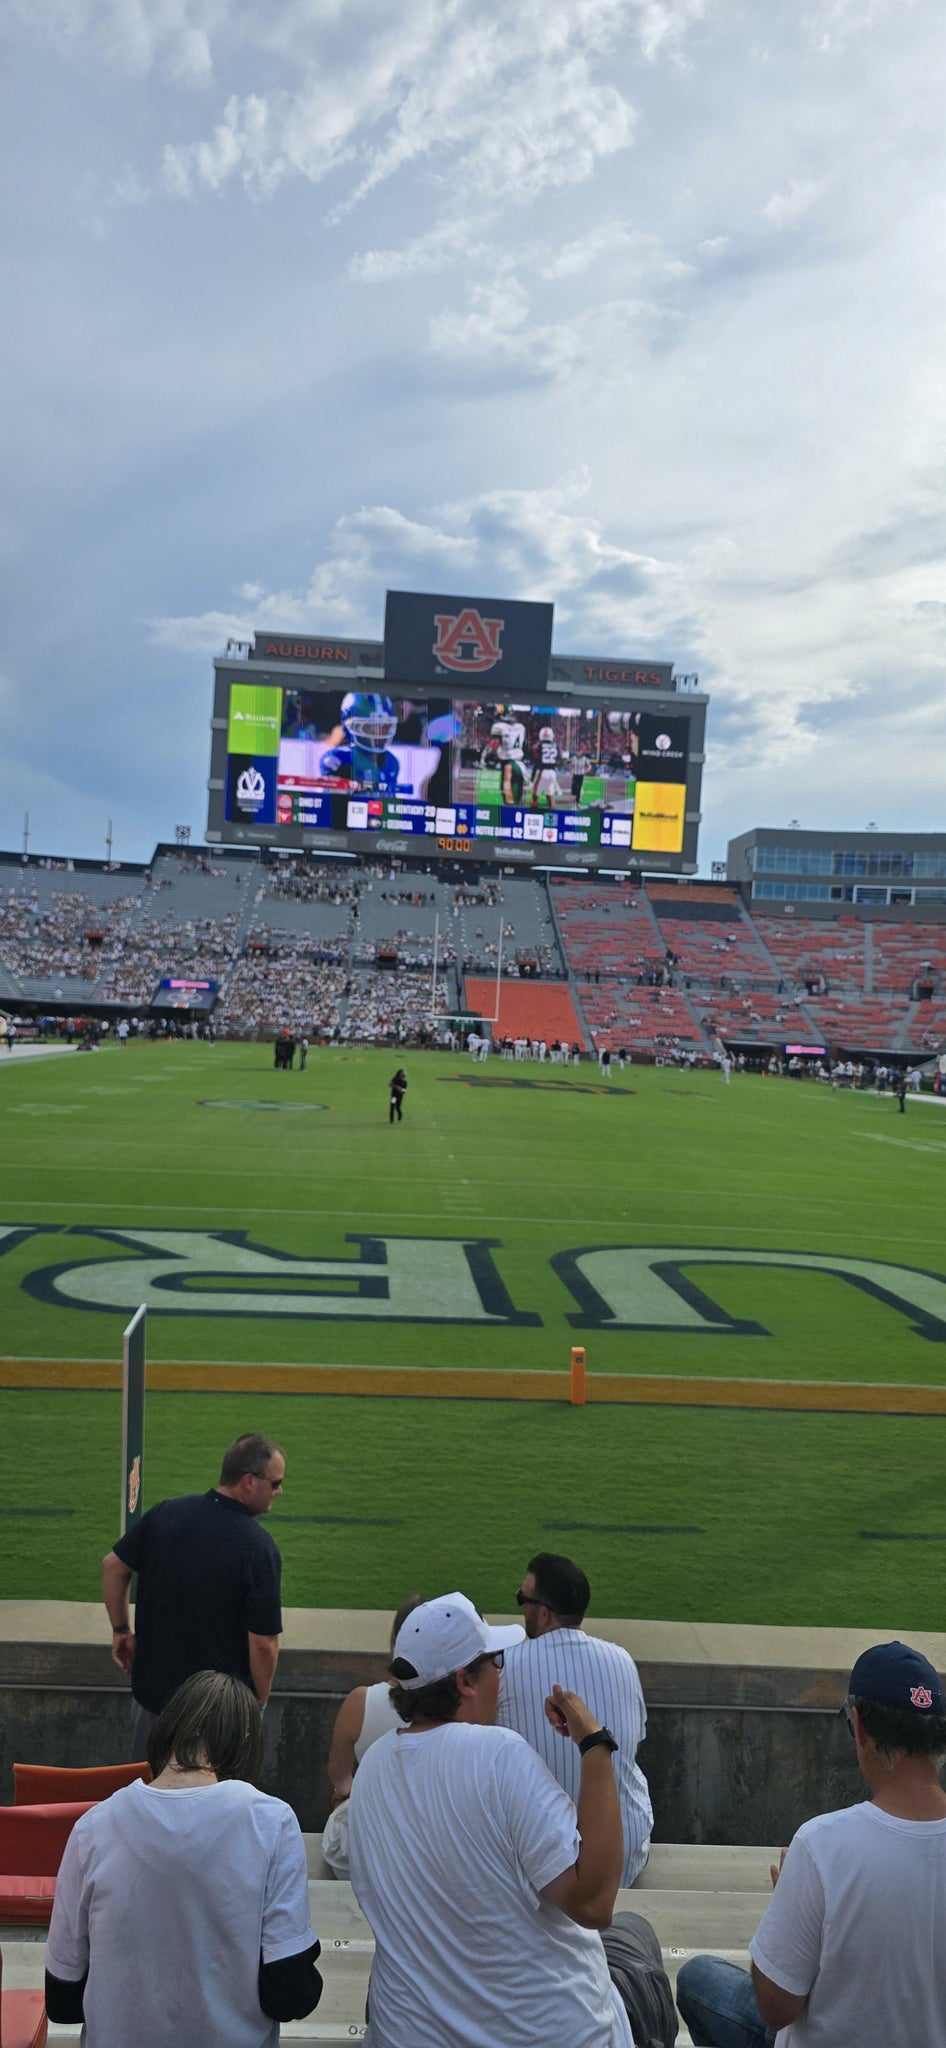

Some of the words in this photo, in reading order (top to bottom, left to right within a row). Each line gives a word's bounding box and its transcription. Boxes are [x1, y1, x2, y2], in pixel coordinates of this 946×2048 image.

[265, 642, 349, 661] AUBURN
[585, 667, 662, 685] TIGERS
[541, 750, 558, 764] 22
[438, 837, 471, 852] 90:00
